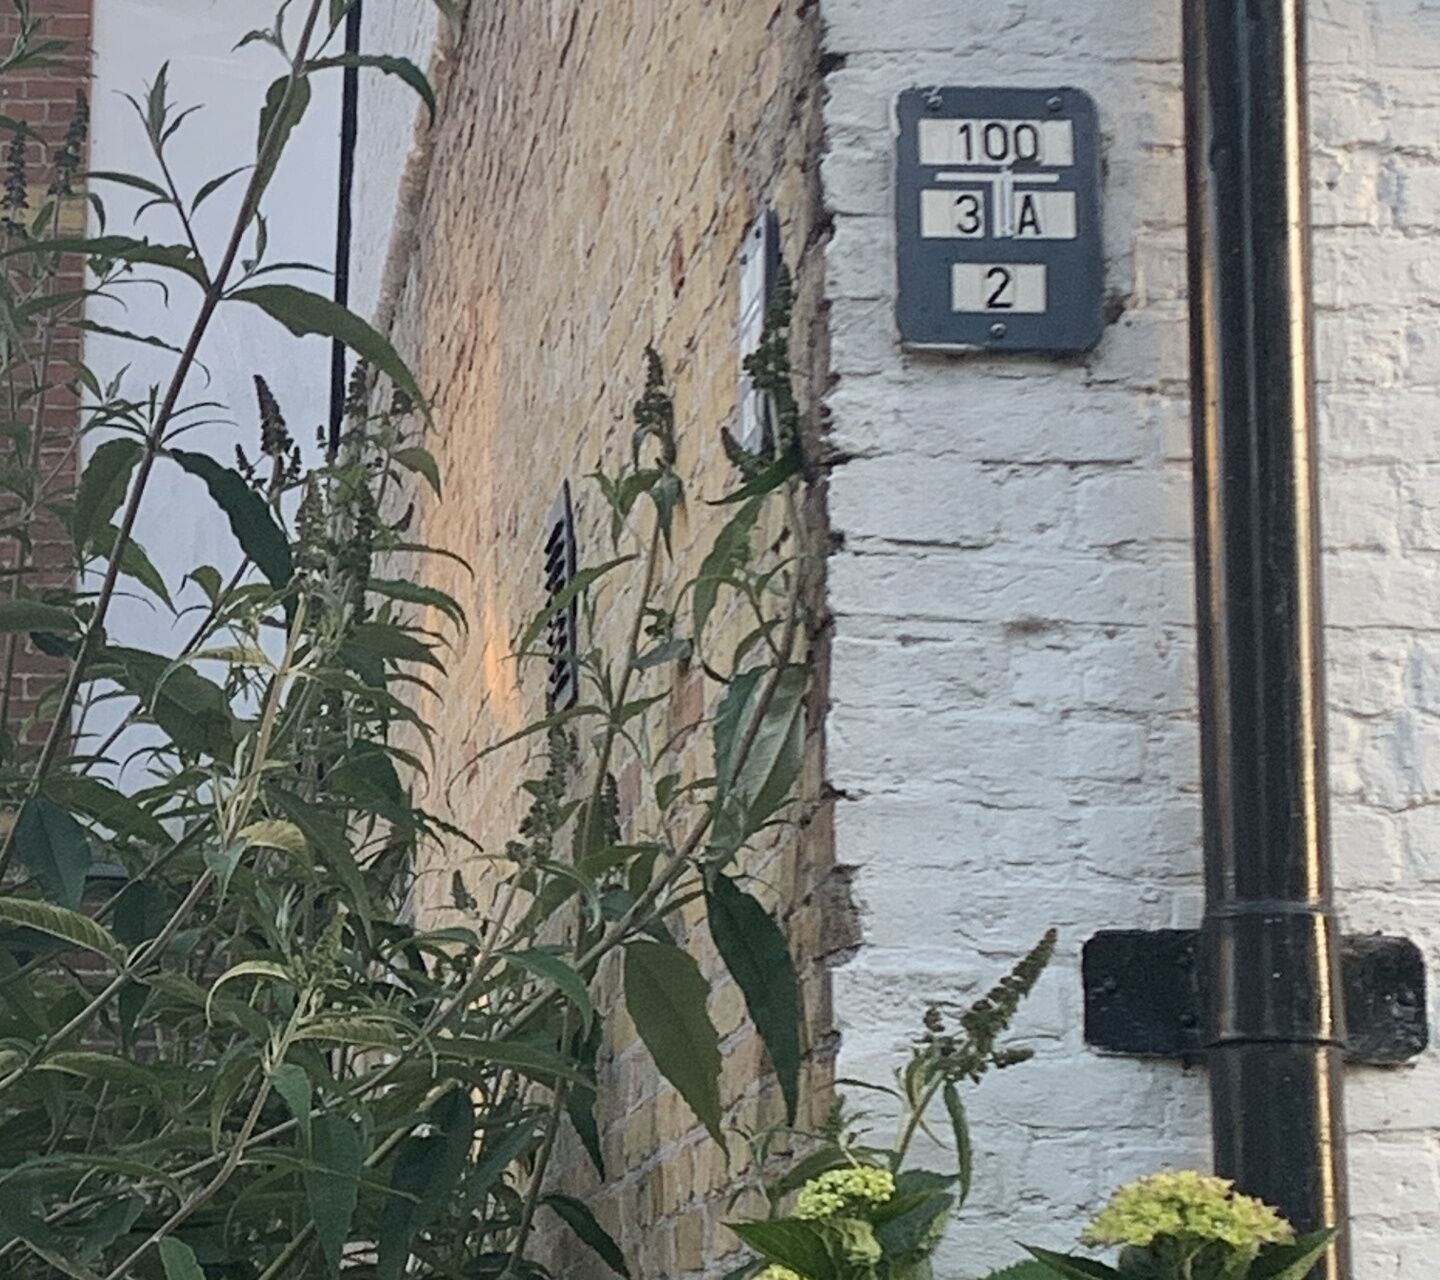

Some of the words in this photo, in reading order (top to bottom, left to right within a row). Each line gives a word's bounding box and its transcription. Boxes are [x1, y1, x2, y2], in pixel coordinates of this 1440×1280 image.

[959, 122, 1040, 162] 100
[955, 195, 980, 234] 3
[1018, 194, 1041, 235] A
[986, 267, 1013, 309] 2
